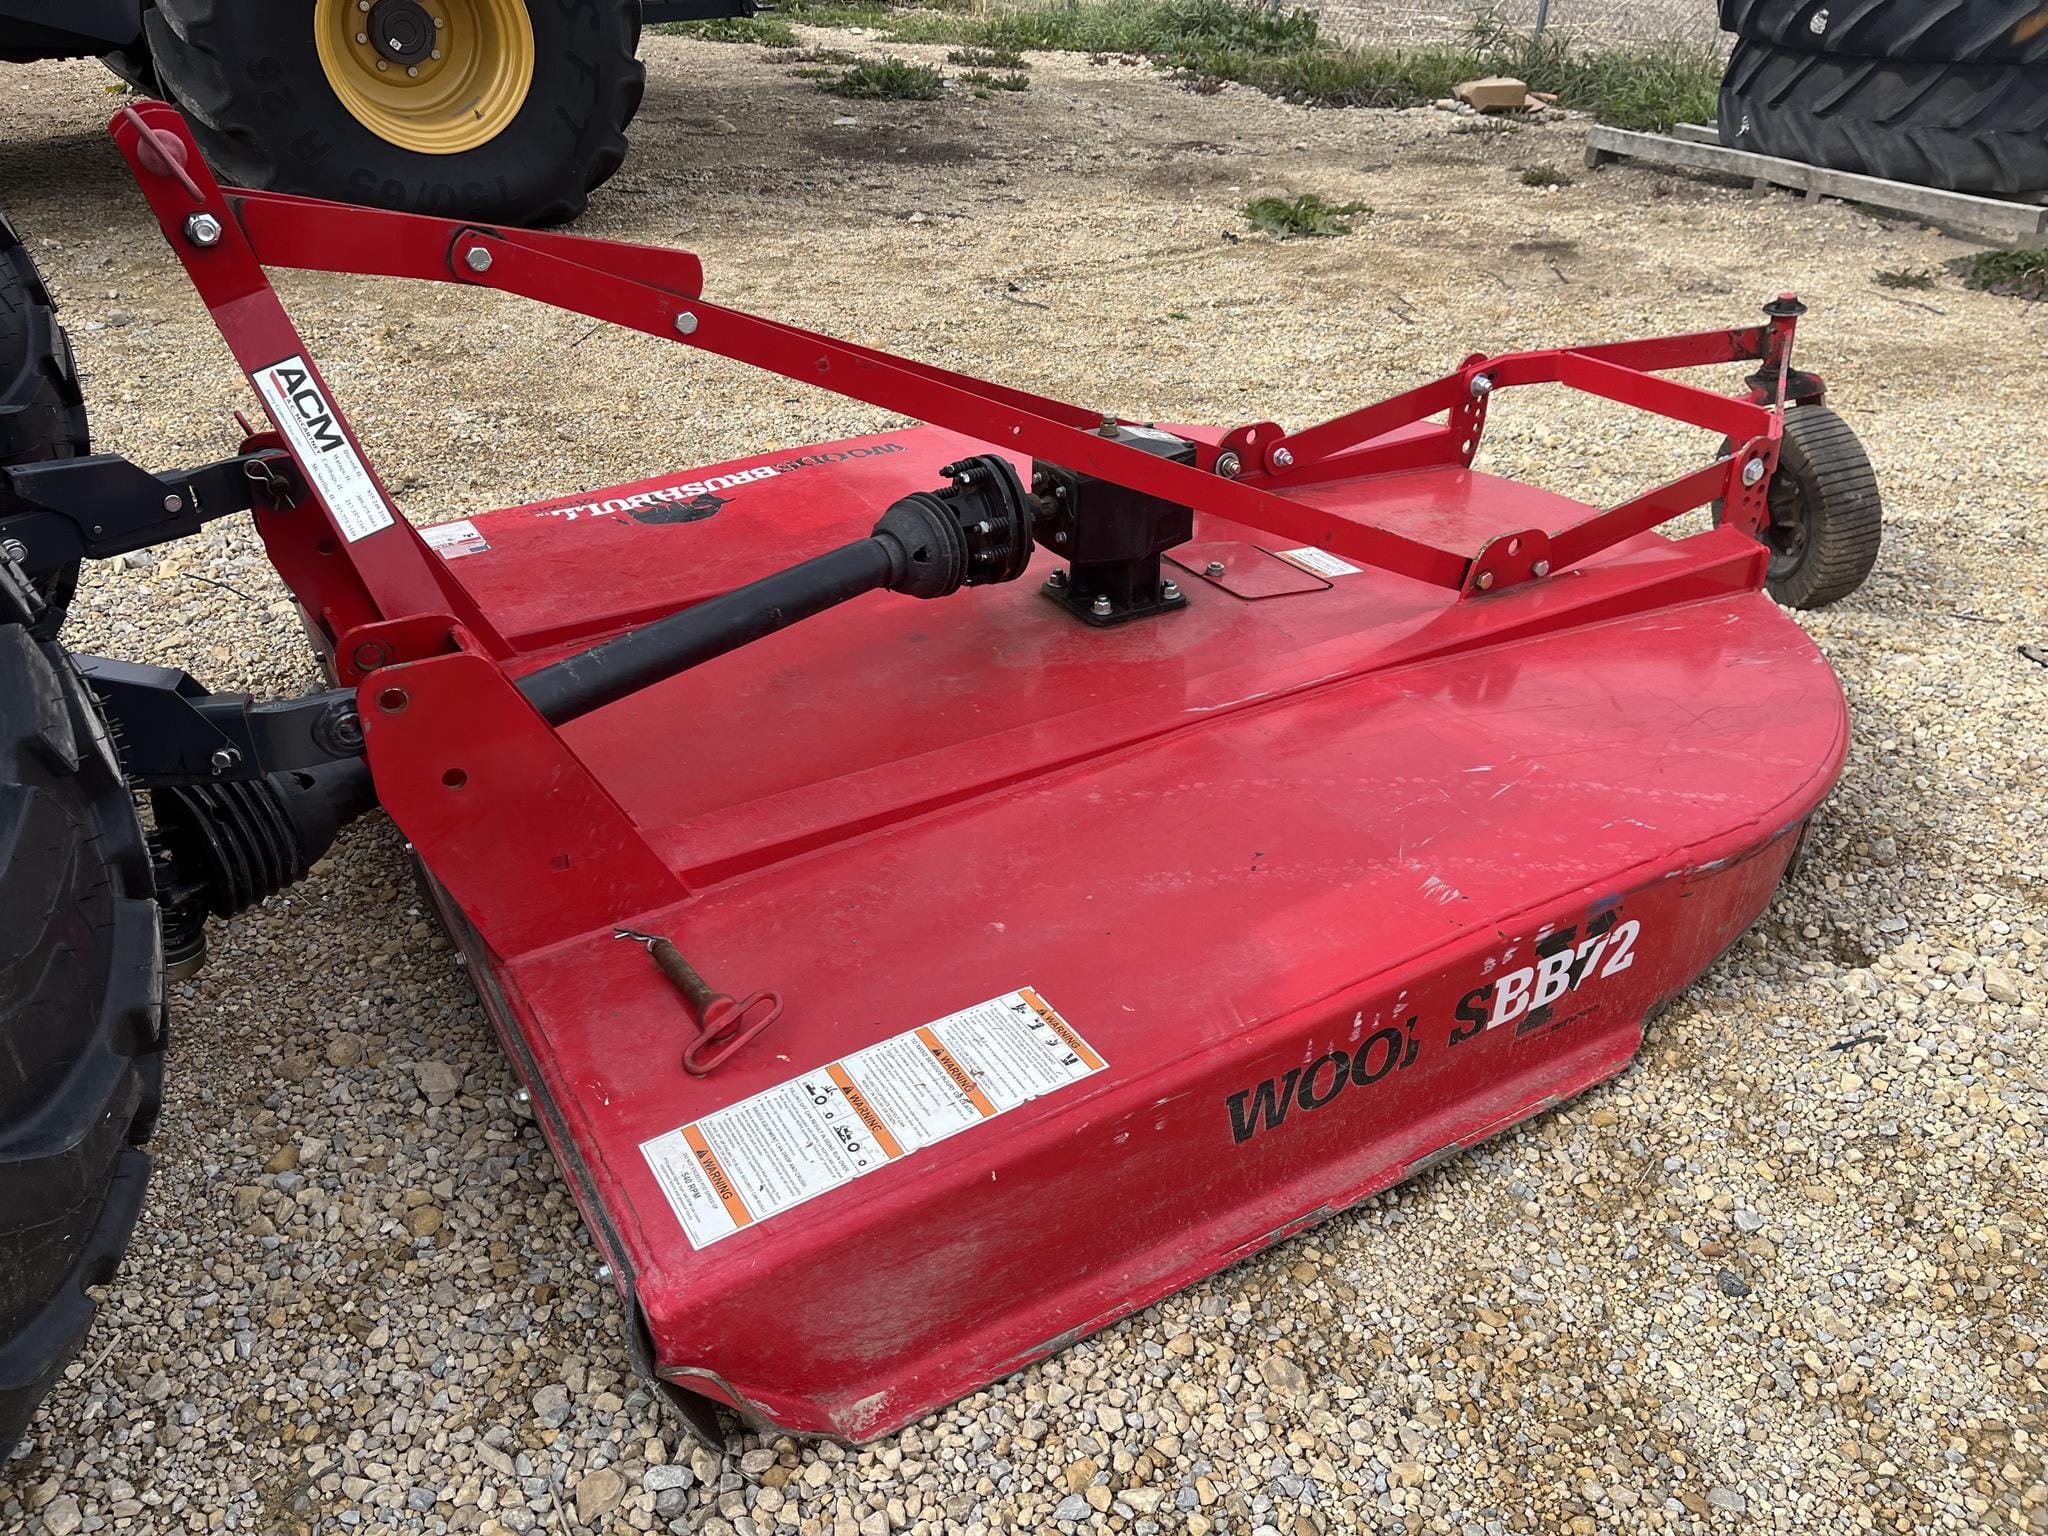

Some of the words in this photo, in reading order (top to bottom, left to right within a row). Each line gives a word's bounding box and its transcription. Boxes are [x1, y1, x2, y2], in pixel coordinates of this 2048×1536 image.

[275, 369, 345, 452] ACM
[1487, 920, 1641, 1030] BB72
[1044, 1015, 1081, 1048] WARNING
[924, 1056, 944, 1075] SERIOUS
[939, 1055, 975, 1092] WARNING
[804, 1110, 813, 1119] CAN
[847, 1093, 883, 1133] WARNING
[775, 1142, 784, 1151] CAN
[680, 1171, 693, 1184] 540
[687, 1183, 701, 1199] RPM
[701, 1157, 733, 1200] WARNING
